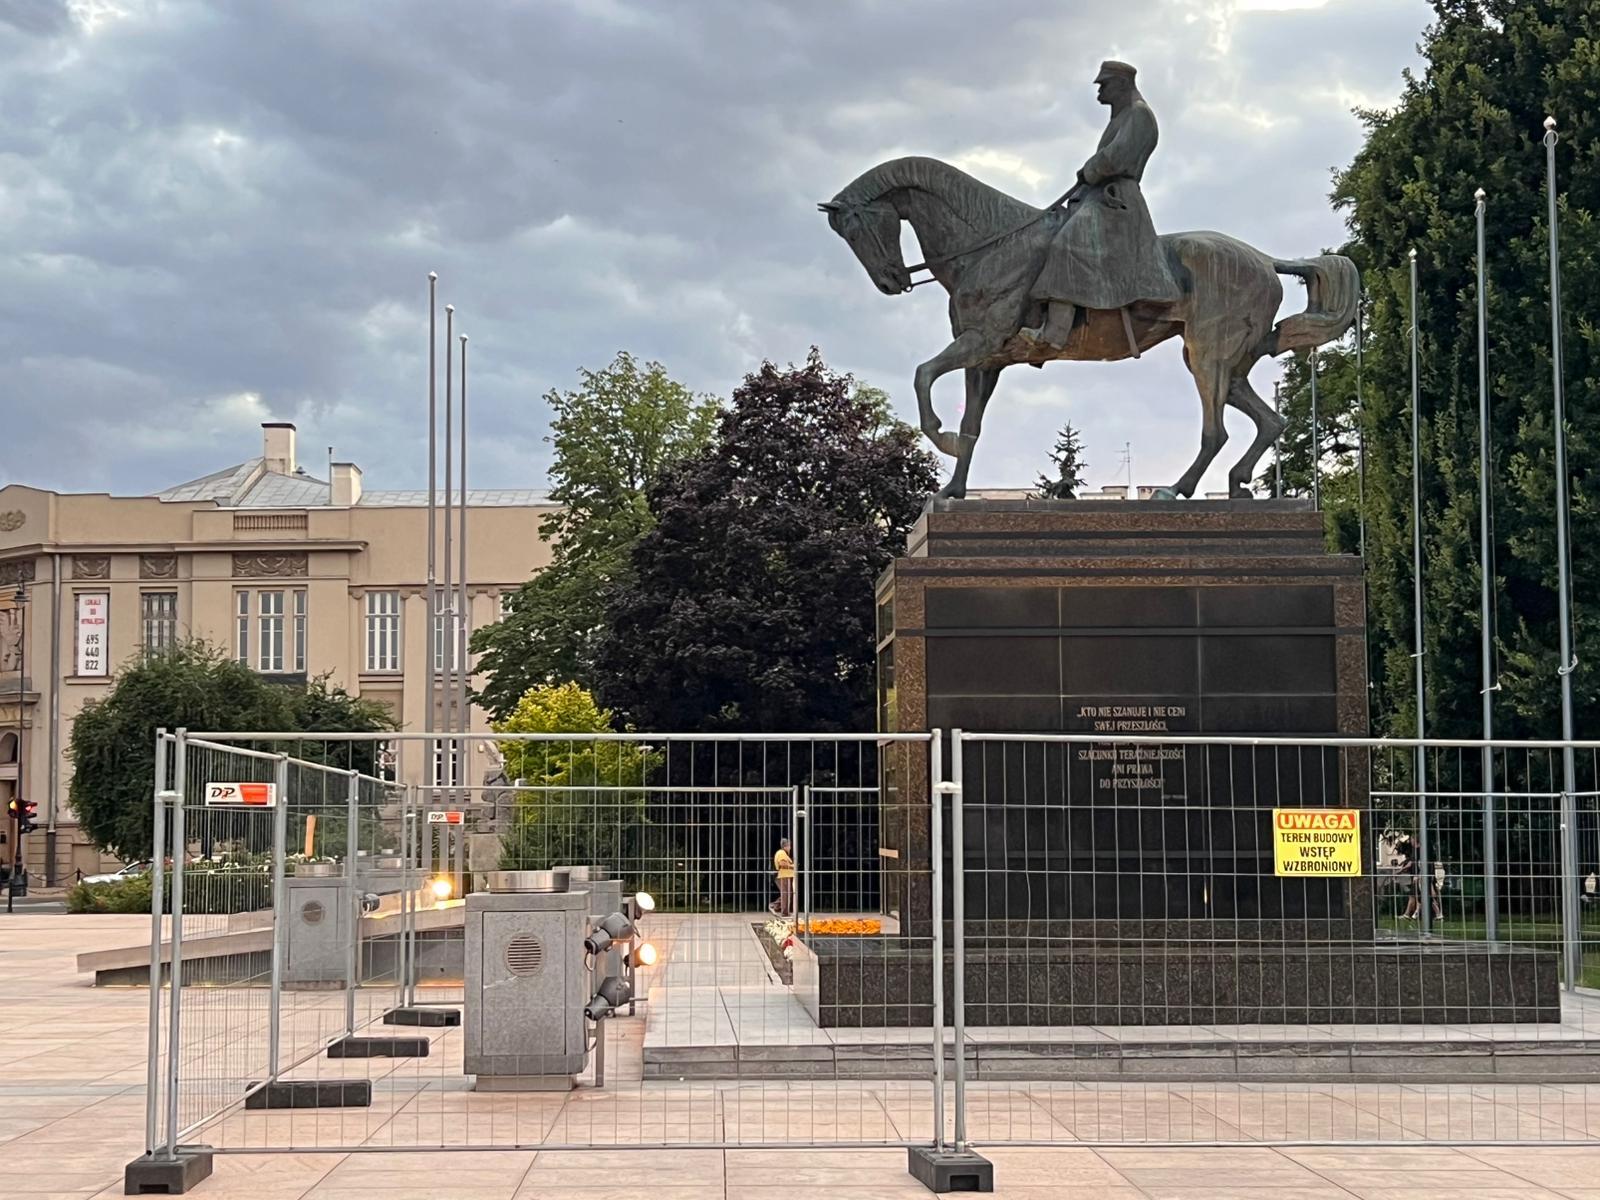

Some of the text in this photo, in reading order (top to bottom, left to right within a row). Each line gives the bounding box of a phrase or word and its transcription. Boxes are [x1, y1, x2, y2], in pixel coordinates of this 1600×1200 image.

[86, 634, 99, 644] 695
[85, 647, 99, 657] 440
[85, 660, 98, 670] 822
[1099, 706, 1111, 717] NIE
[1113, 706, 1146, 717] SZANUJE
[1148, 706, 1151, 717] I
[1153, 706, 1166, 717] NIE
[1167, 706, 1185, 716] CENI
[1095, 721, 1115, 731] SWEJ
[1100, 779, 1110, 788] DO
[1280, 814, 1353, 829] UWAGA
[1281, 833, 1353, 843] TEREN BUDOWY
[1300, 846, 1336, 860] WSTĘP
[1283, 861, 1353, 872] WZBRONIONY
